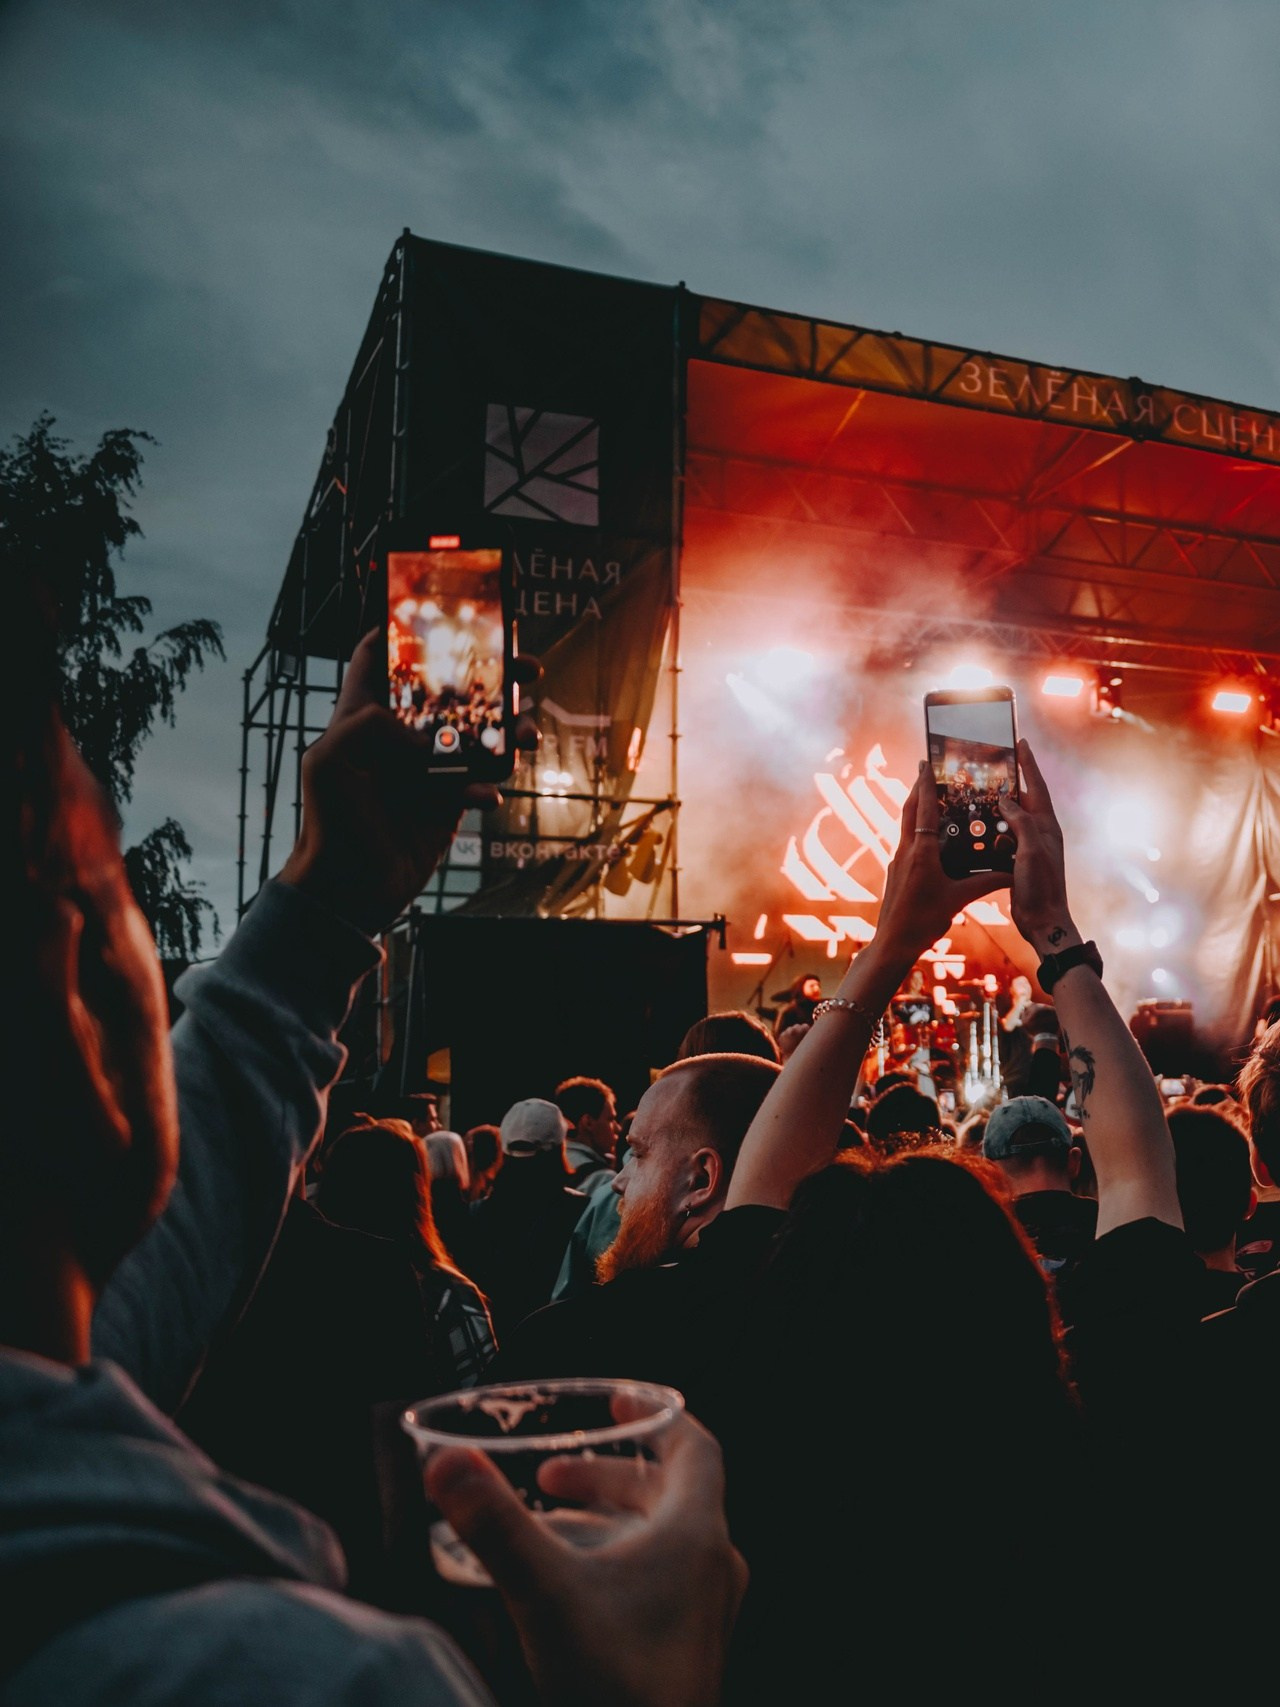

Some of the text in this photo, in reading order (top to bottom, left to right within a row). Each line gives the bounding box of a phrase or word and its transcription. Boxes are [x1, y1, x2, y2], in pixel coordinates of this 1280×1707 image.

[959, 361, 1156, 425] ЗЕЛЁНАЯ
[513, 547, 621, 585] ЁНАЯ
[514, 589, 603, 620] ЦЕНА
